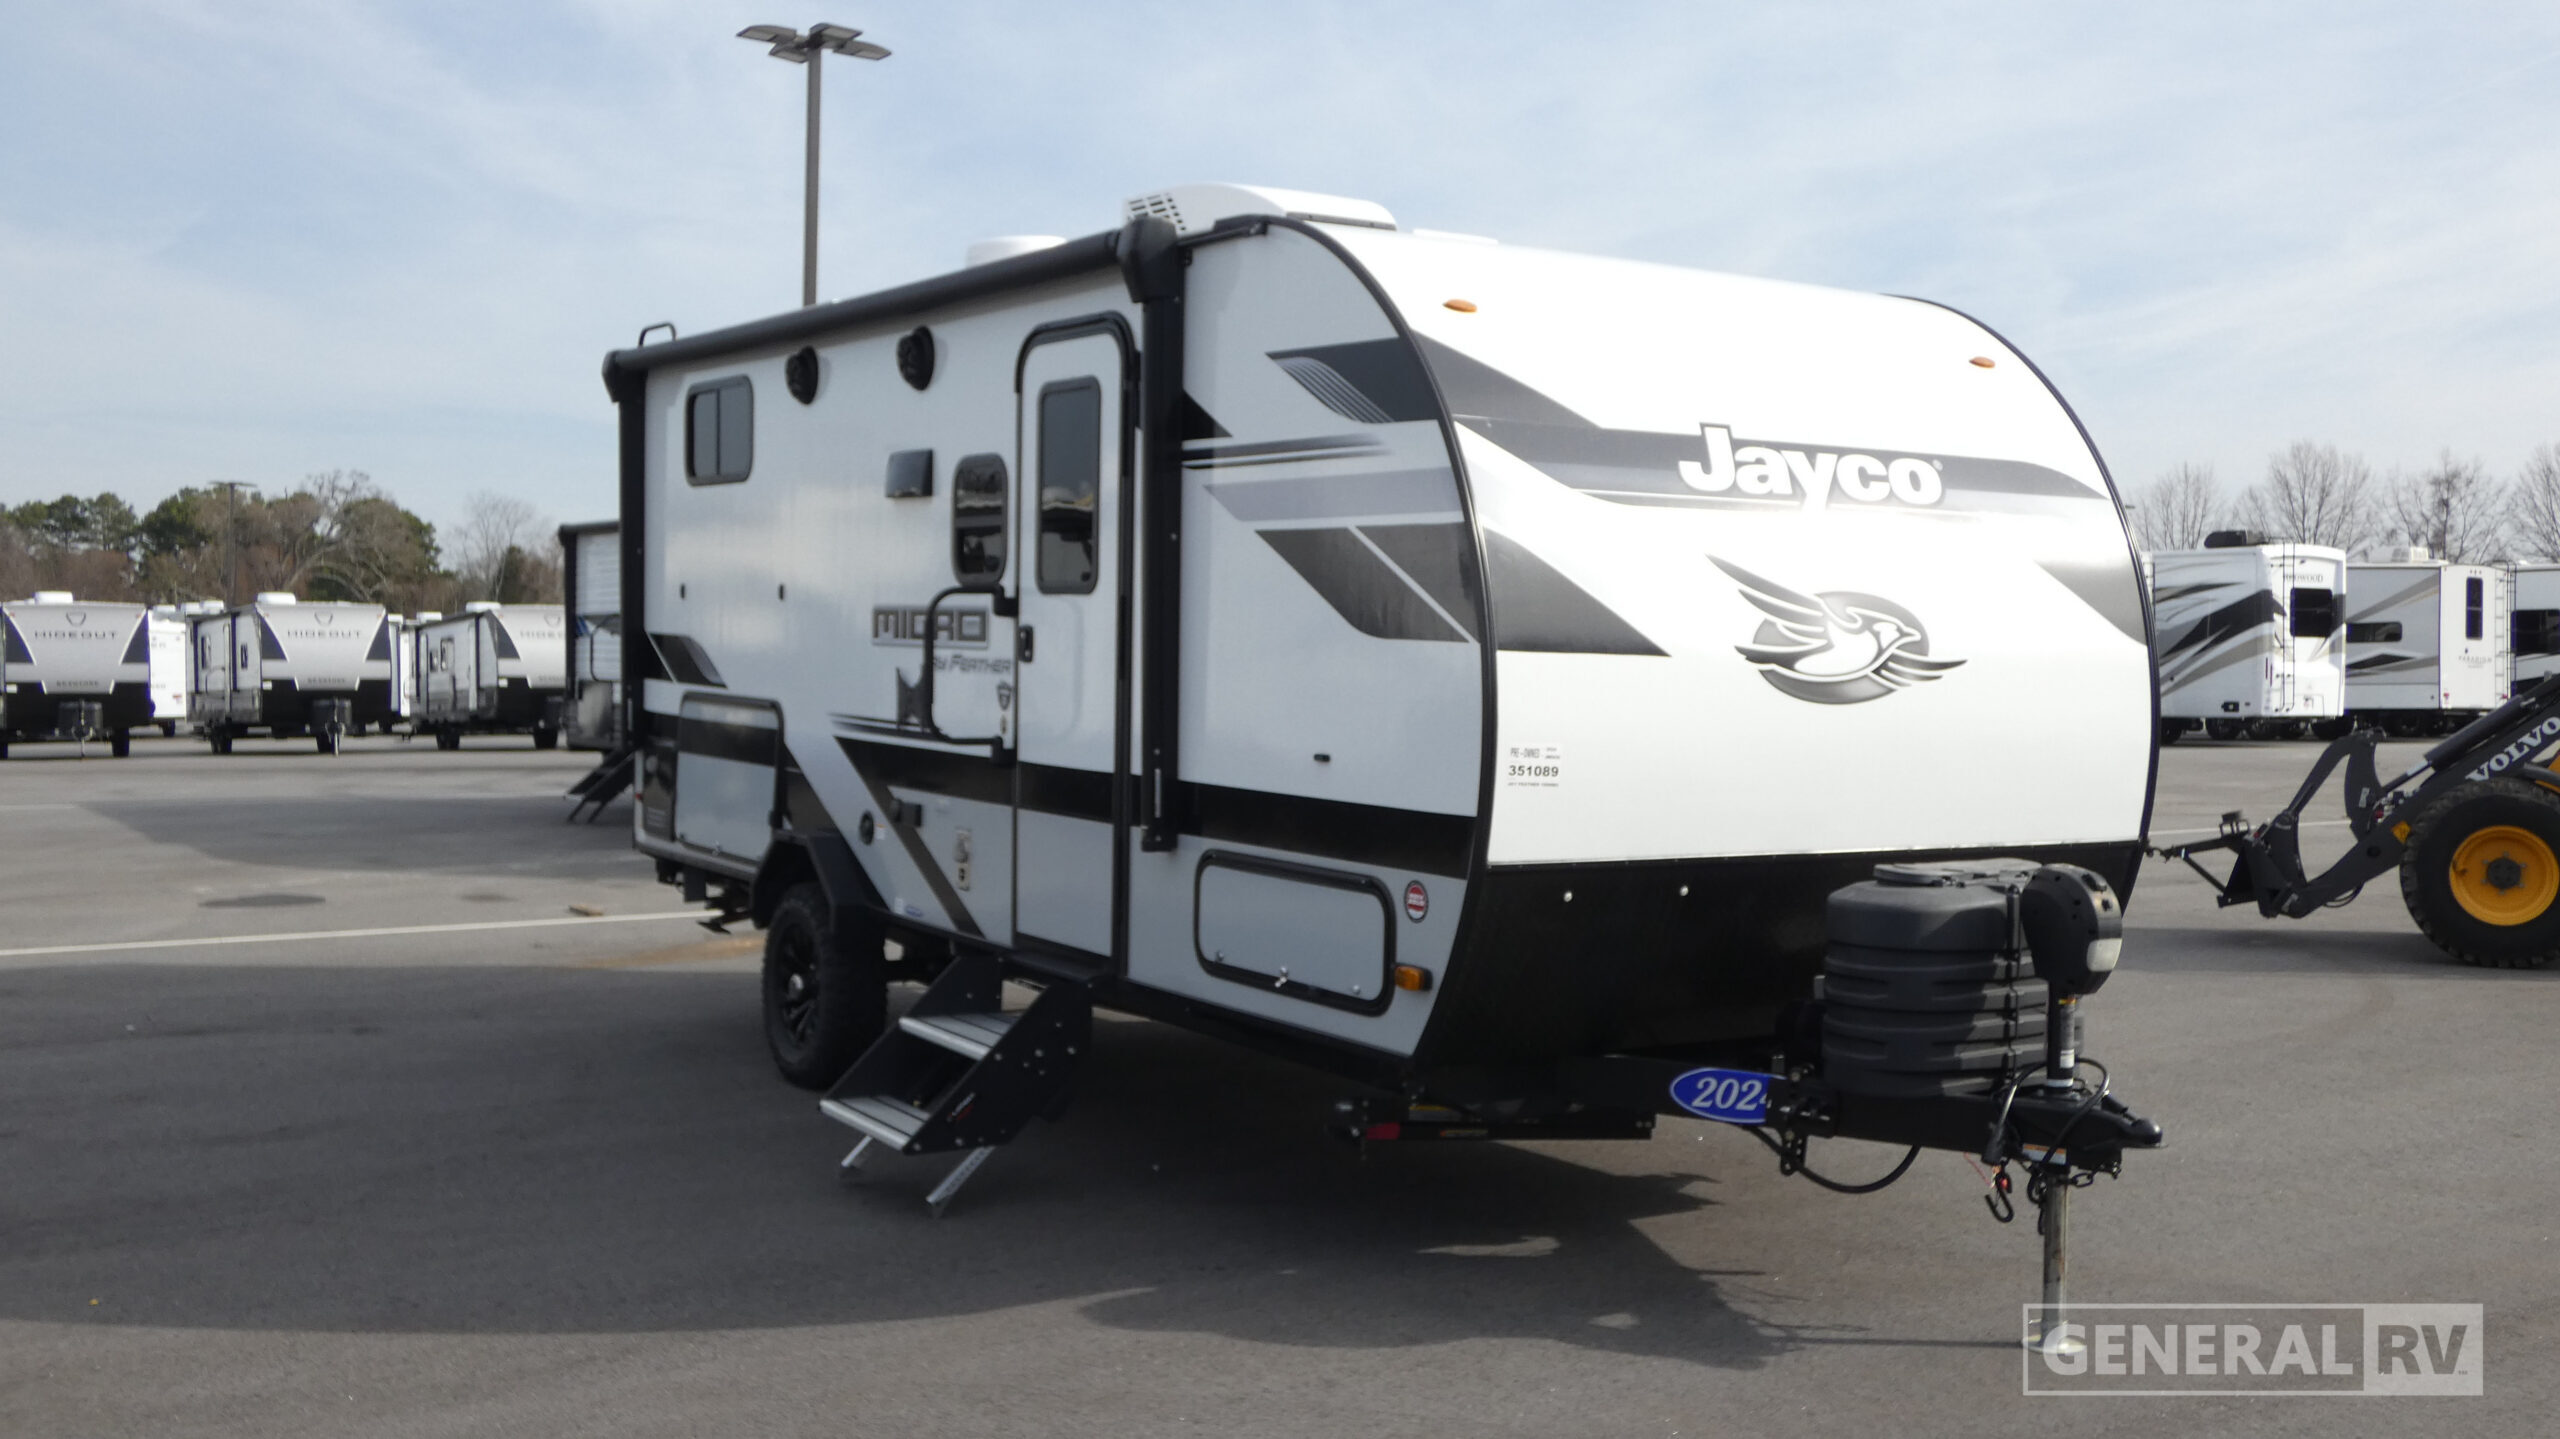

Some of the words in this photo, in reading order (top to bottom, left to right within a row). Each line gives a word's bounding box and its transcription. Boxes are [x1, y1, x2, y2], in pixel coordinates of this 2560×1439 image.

[1677, 422, 1943, 510] Jayco
[34, 630, 117, 640] HIDEOUT
[287, 629, 362, 639] HIDEOUT
[872, 609, 988, 643] MICRO
[2465, 716, 2560, 781] VOLVO
[1508, 764, 1559, 777] 351089
